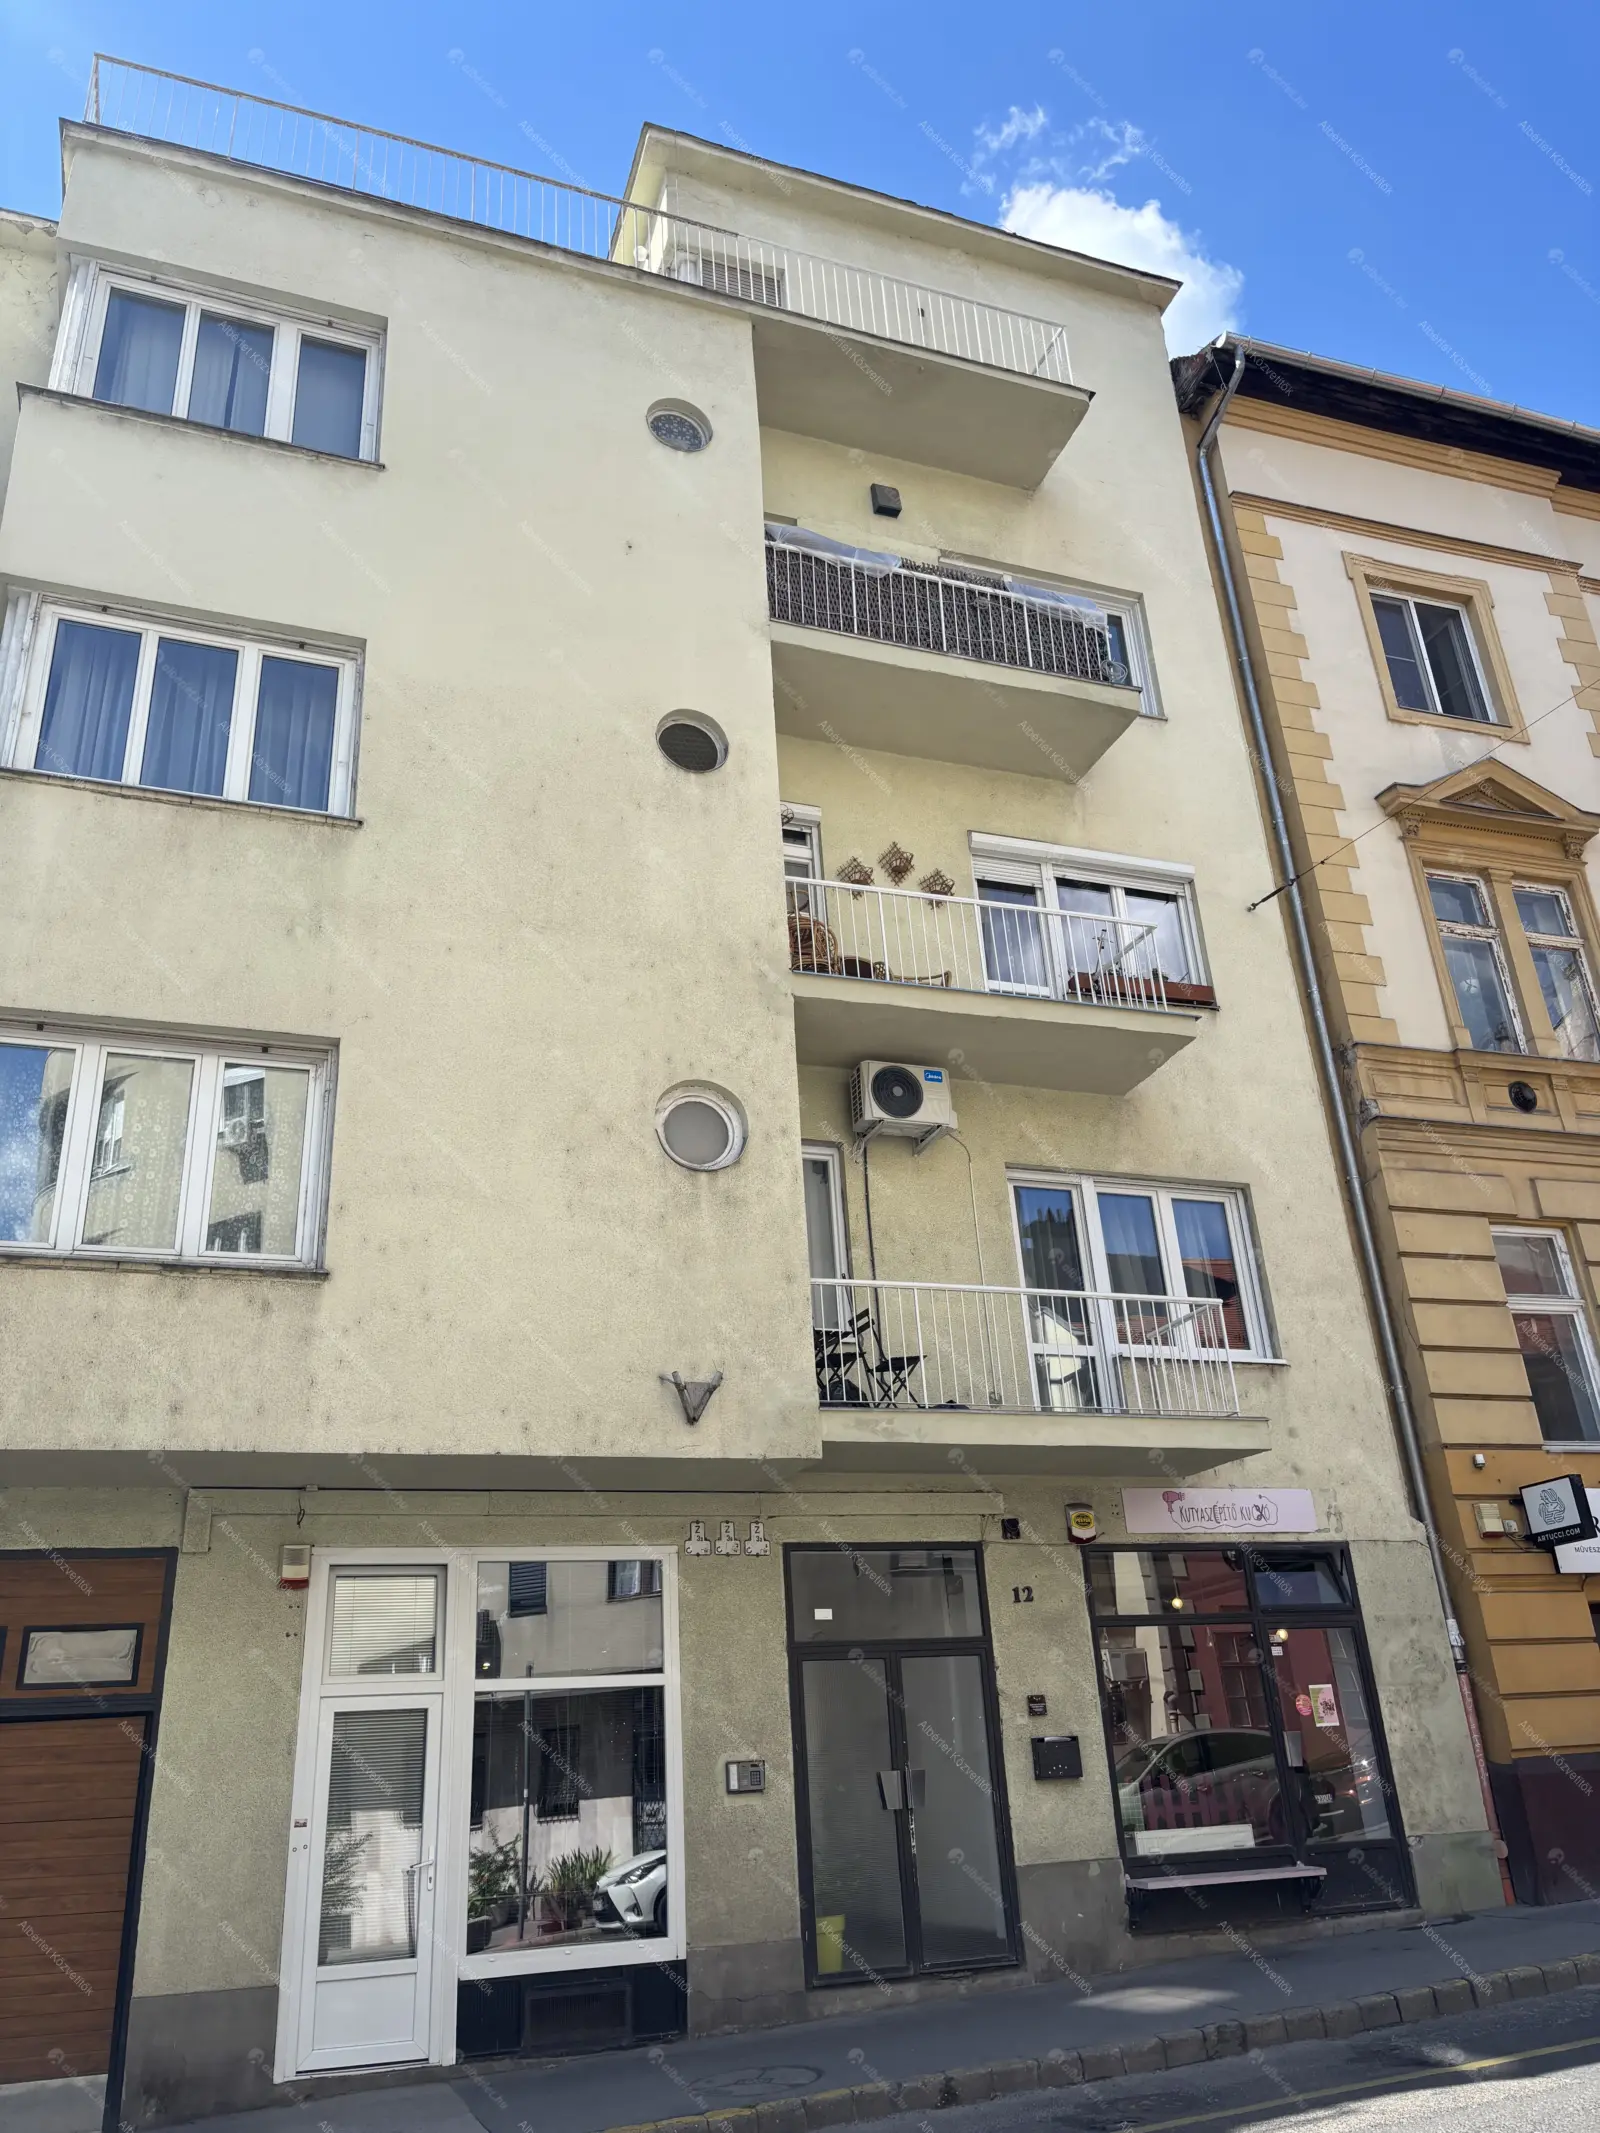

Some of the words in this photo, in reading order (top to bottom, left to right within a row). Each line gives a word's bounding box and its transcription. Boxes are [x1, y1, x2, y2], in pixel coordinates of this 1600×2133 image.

[1179, 1501, 1238, 1524] KUTYASZÉPÍTŐ
[1537, 1527, 1581, 1542] ARTUCCI.COM
[1011, 1586, 1034, 1604] 12
